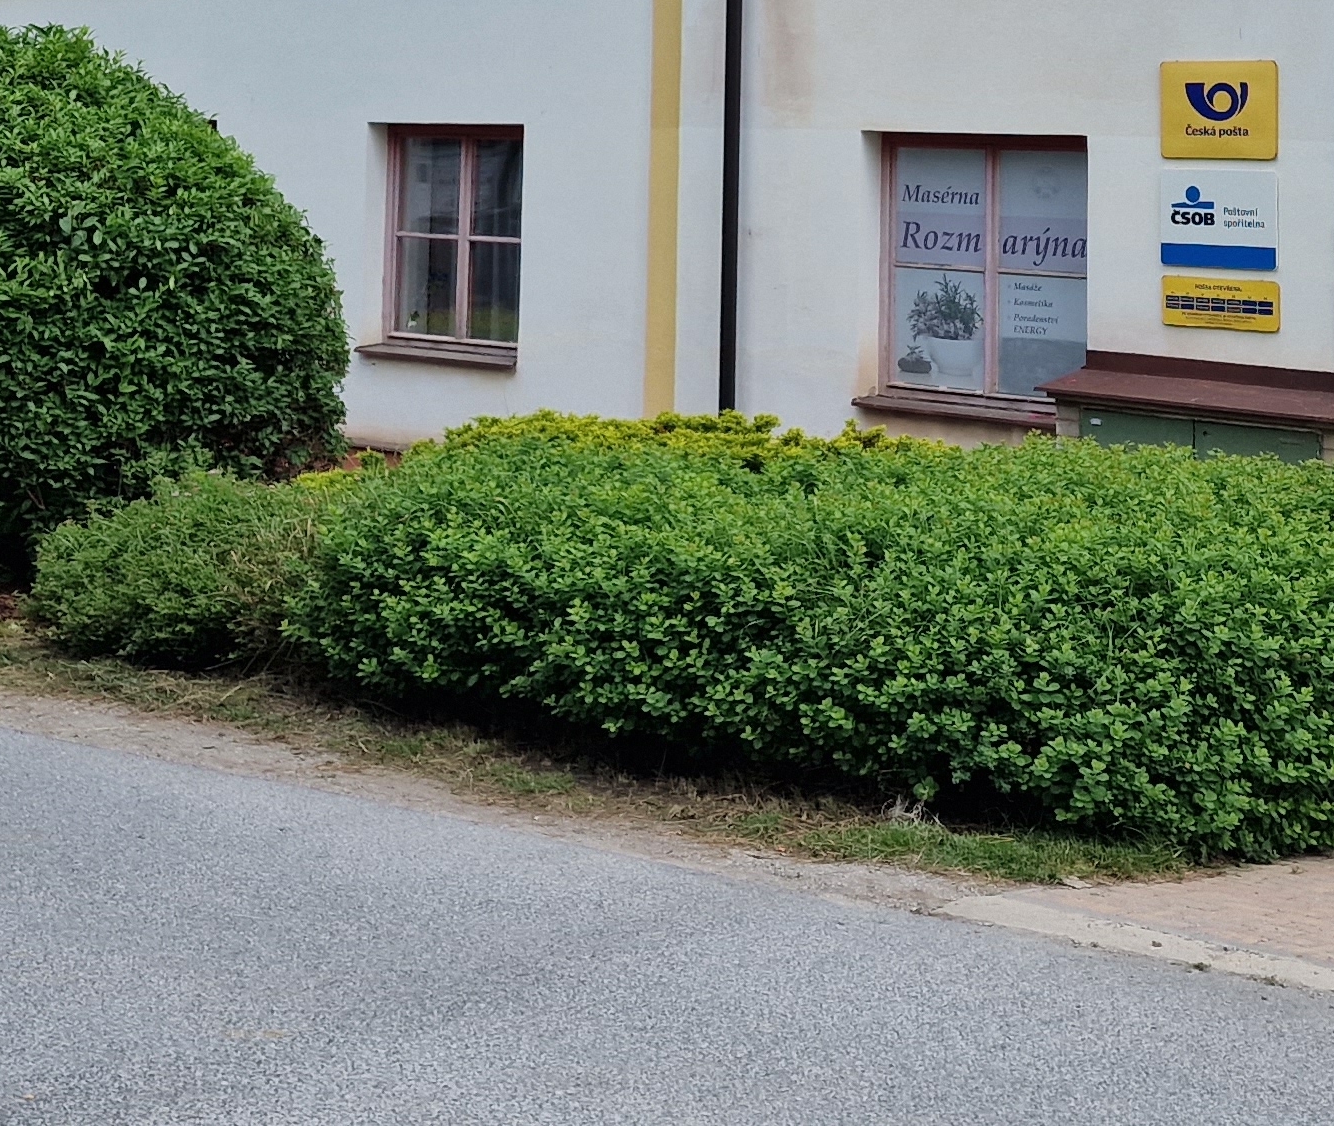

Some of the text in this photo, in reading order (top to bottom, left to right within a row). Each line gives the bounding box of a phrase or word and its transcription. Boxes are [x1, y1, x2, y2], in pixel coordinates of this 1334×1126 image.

[1185, 124, 1249, 138] Česká pošta
[902, 184, 980, 205] Masérna
[1171, 209, 1215, 226] ČSOB
[1223, 207, 1258, 217] Poštovní
[1223, 220, 1265, 229] spořitelna
[1013, 325, 1048, 335] ENERGY
